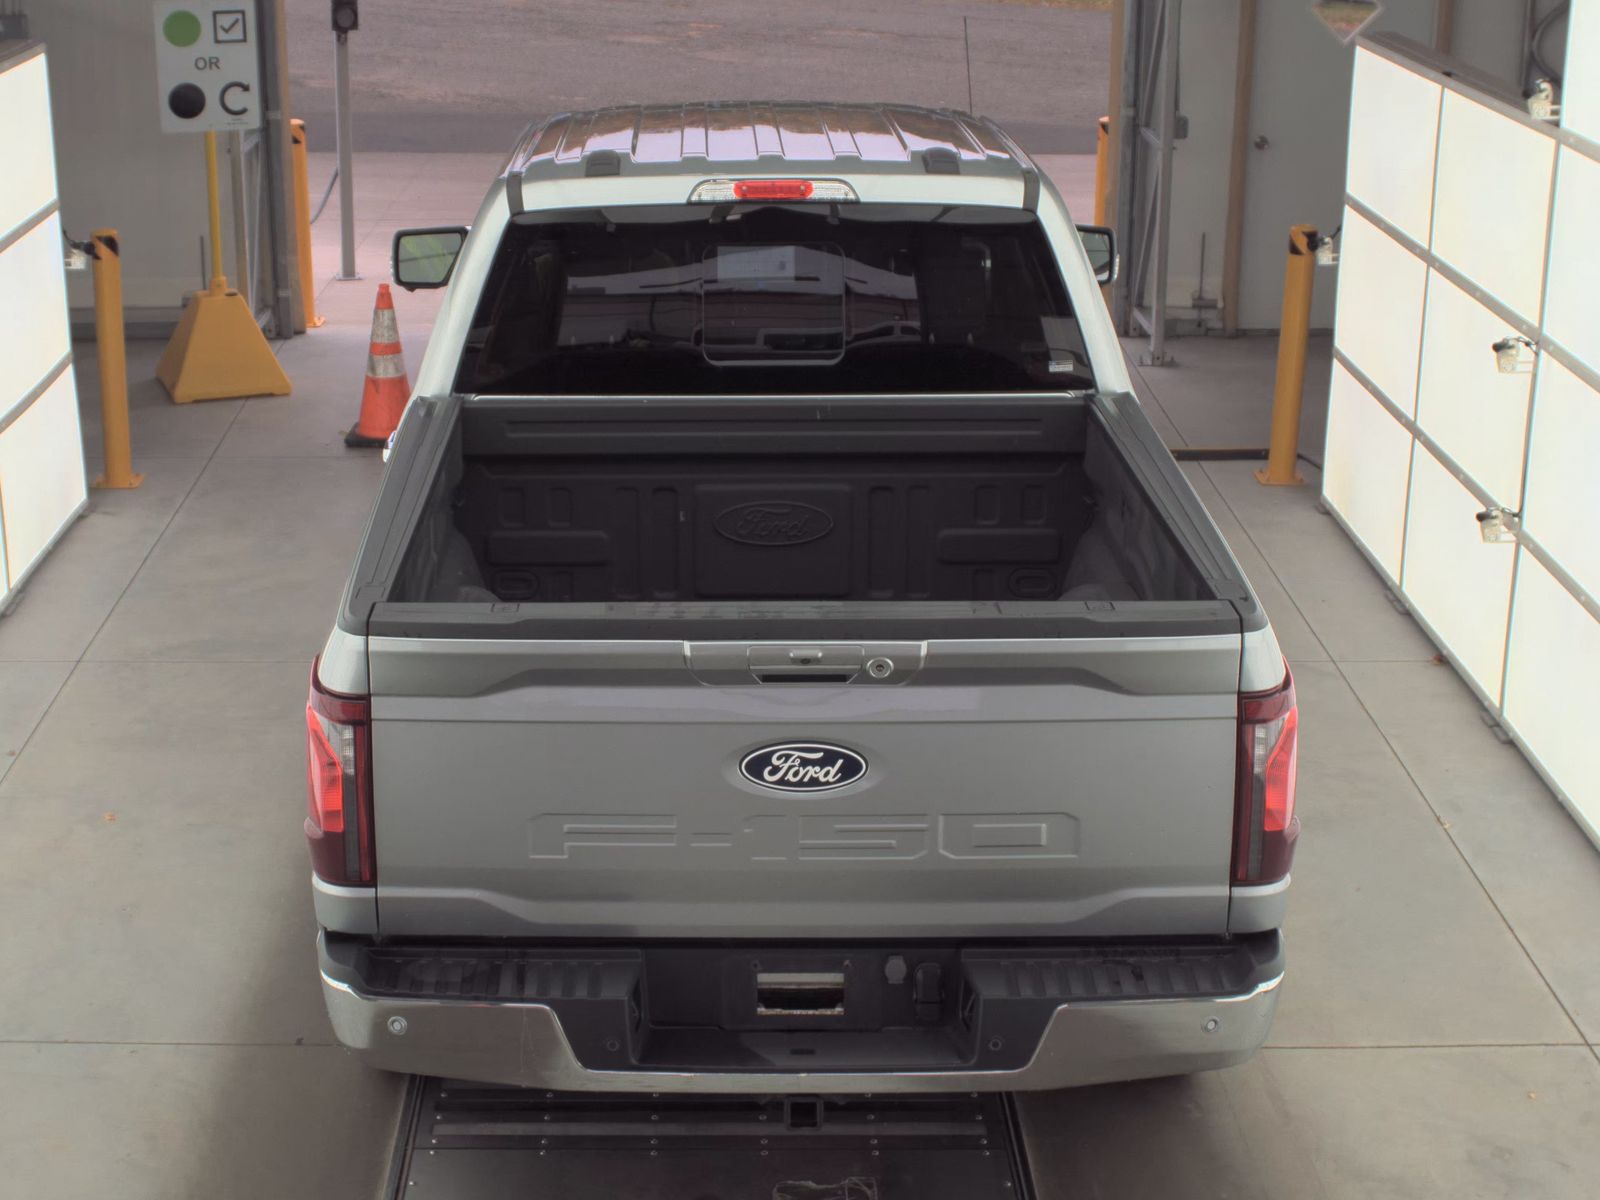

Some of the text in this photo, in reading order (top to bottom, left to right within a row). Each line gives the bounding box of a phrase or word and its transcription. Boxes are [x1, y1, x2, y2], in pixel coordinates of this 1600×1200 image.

[195, 56, 220, 71] OR
[736, 506, 808, 538] Ford
[763, 750, 844, 782] Ford
[529, 812, 1081, 860] F-150
